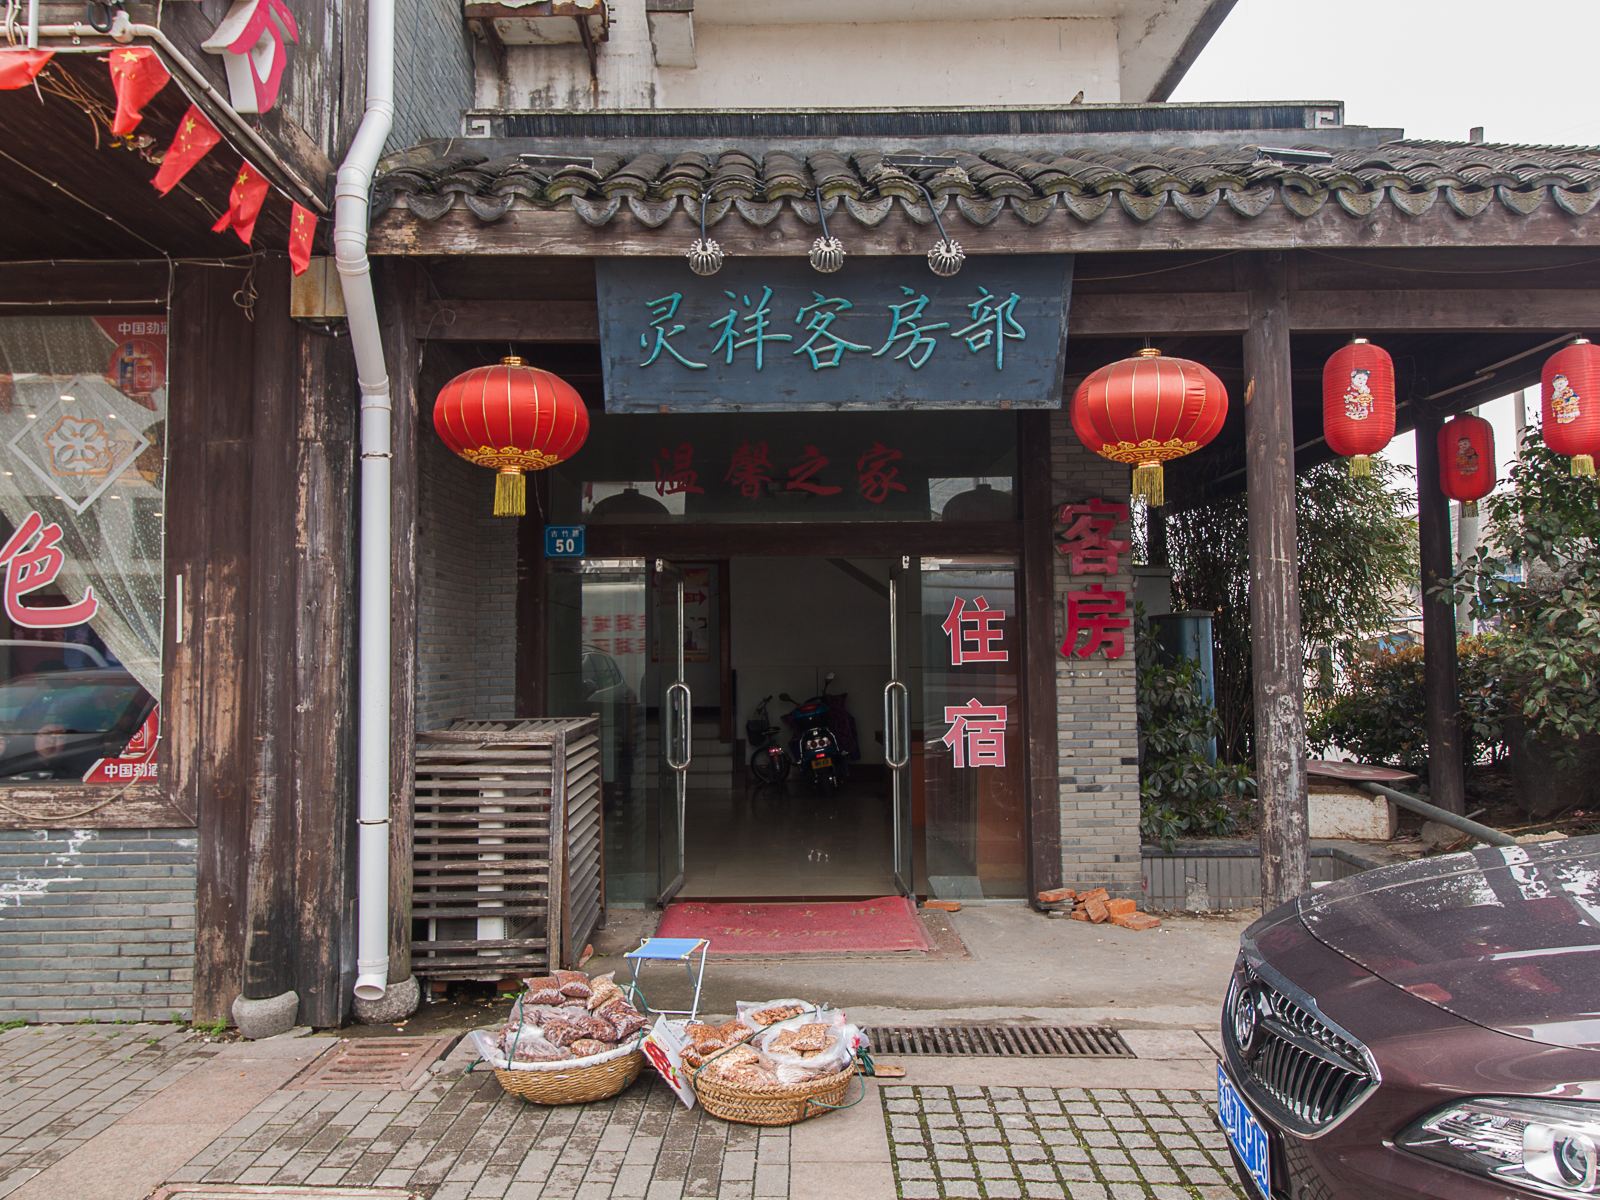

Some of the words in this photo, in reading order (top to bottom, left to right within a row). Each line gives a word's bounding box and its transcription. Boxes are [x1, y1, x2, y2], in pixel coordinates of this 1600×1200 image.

[640, 286, 1027, 371] 灵祥客房部
[652, 441, 908, 504] 温馨之家
[0, 511, 99, 628] 色
[555, 539, 575, 552] 50
[1055, 498, 1131, 659] 客房
[941, 595, 1009, 768] 住宿
